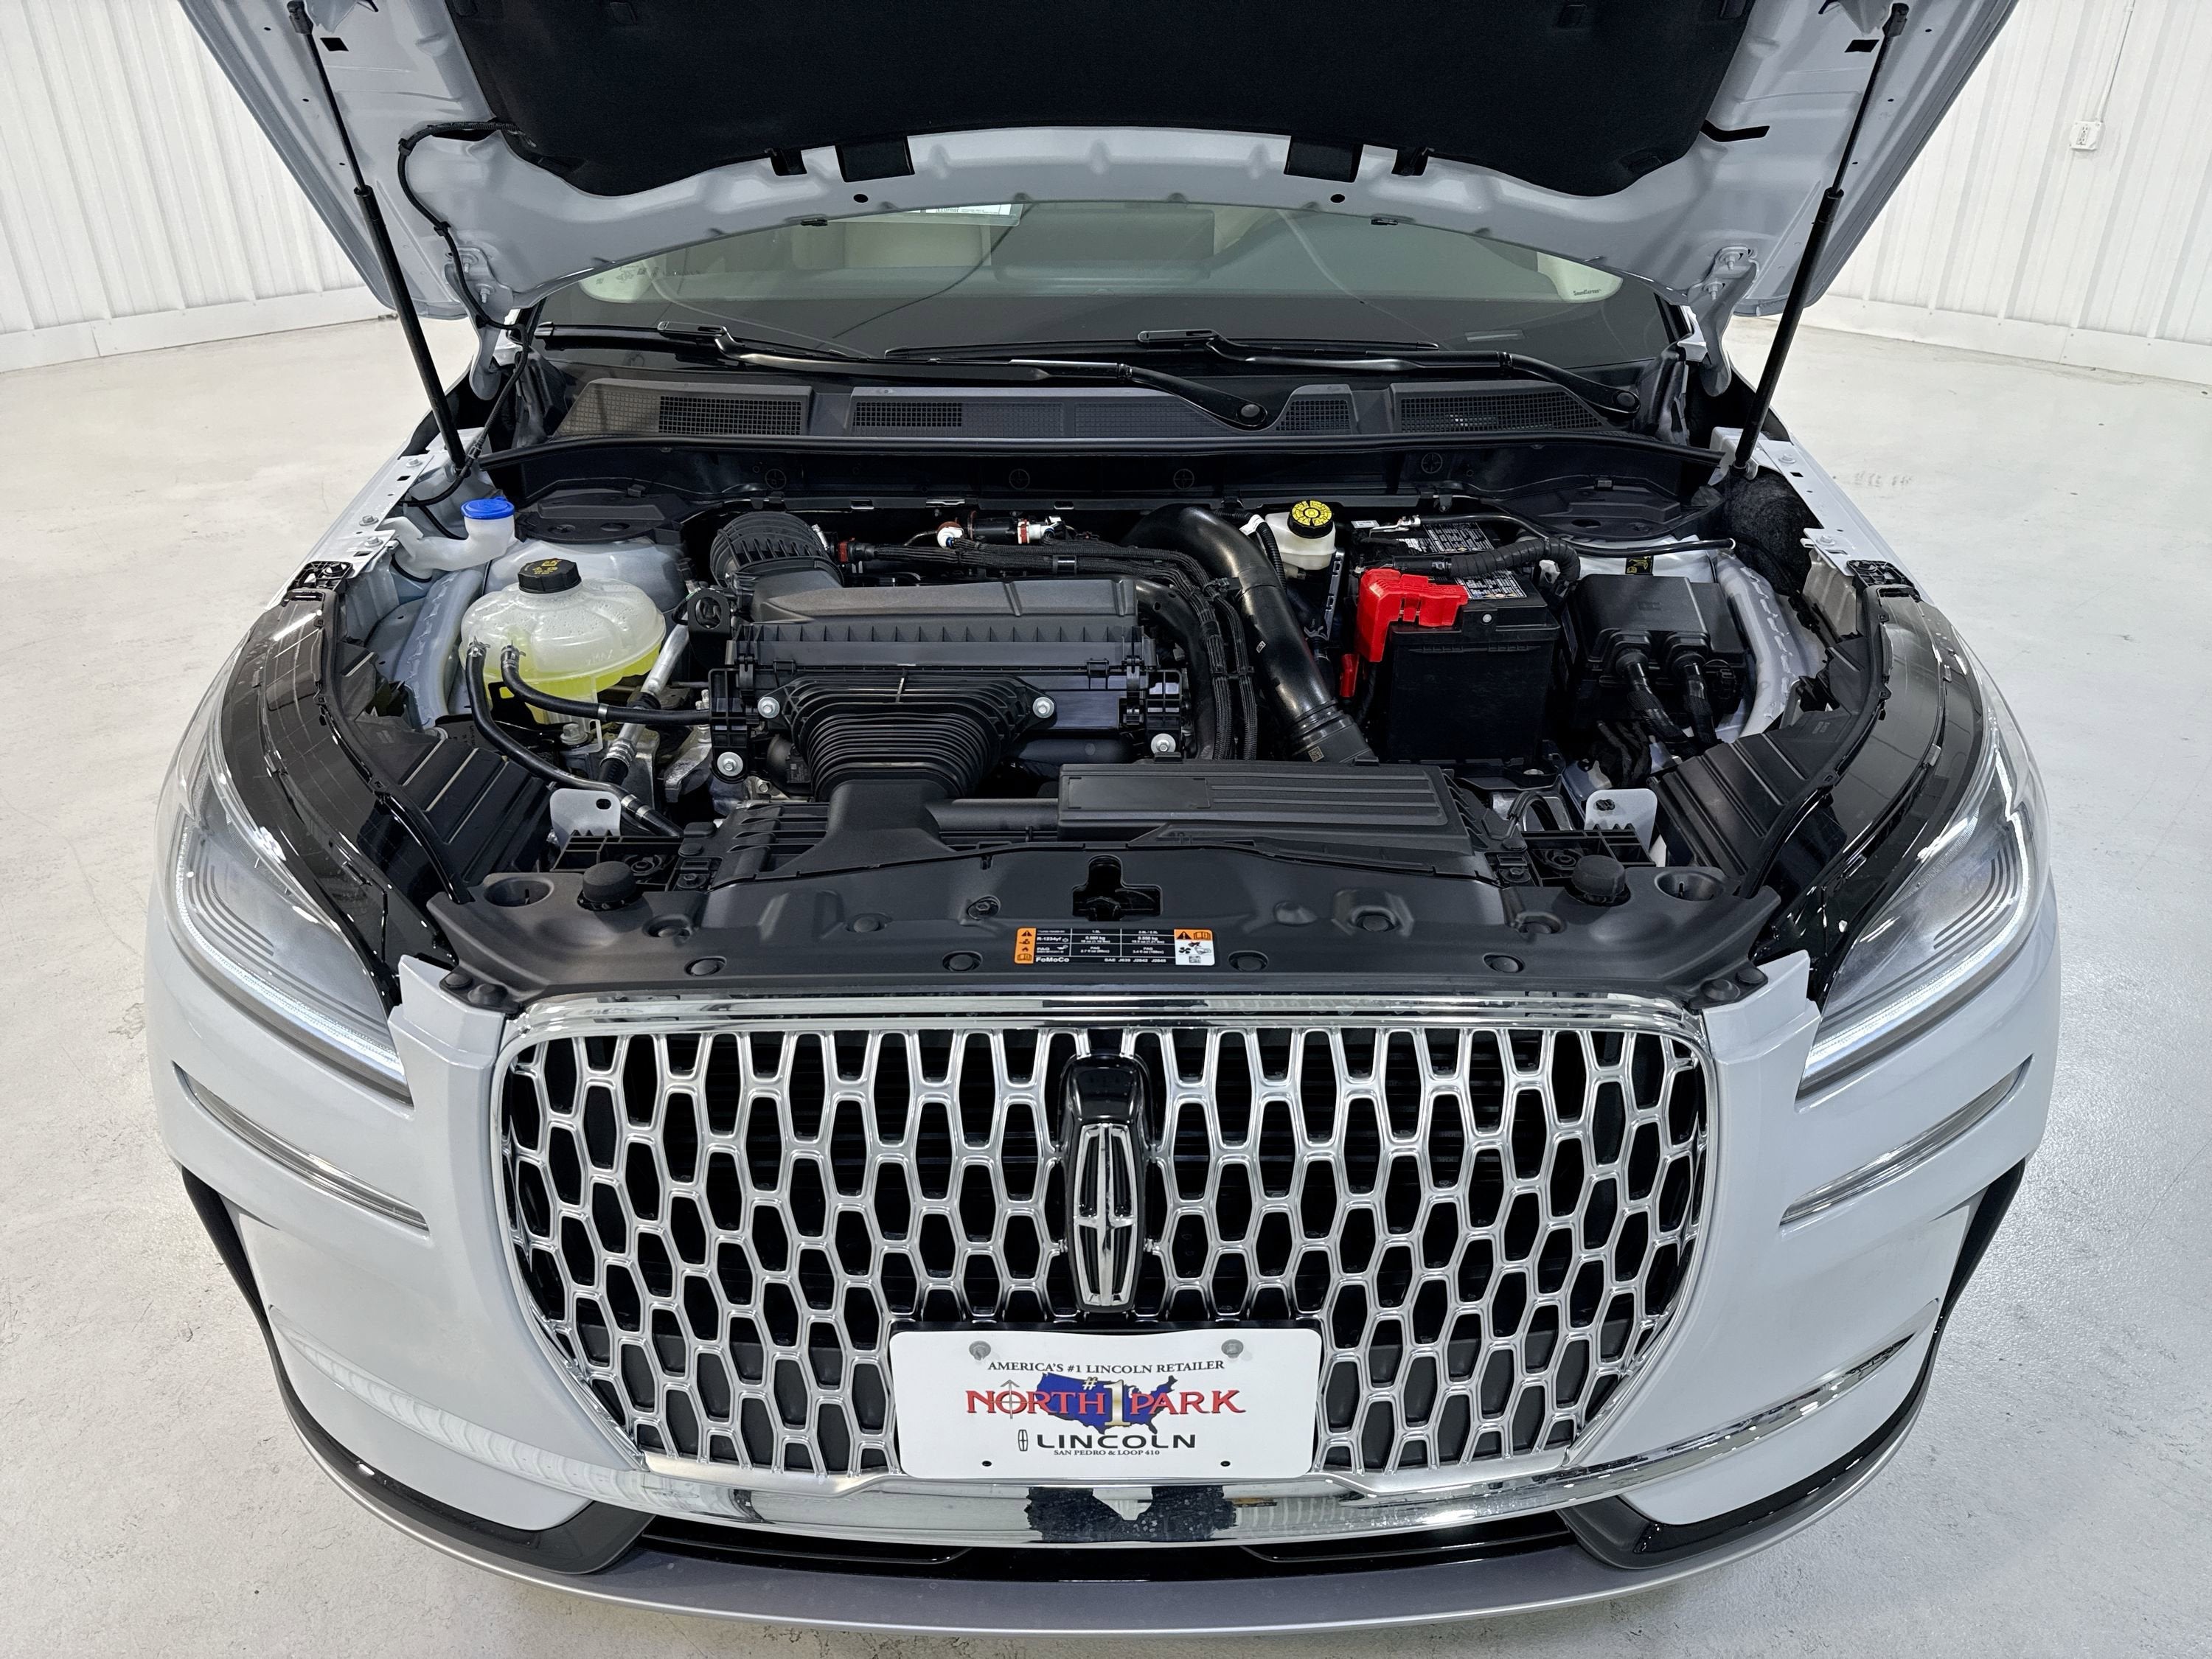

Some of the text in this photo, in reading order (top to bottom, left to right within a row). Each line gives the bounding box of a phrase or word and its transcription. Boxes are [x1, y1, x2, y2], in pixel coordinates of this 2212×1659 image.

[987, 1362, 1063, 1372] AMERICA'S
[1087, 1365, 1152, 1374] LINCOLN
[1157, 1360, 1225, 1373] RETAILER
[966, 1389, 1246, 1415] NORTH PARK
[1037, 1434, 1195, 1449] LINCOLN
